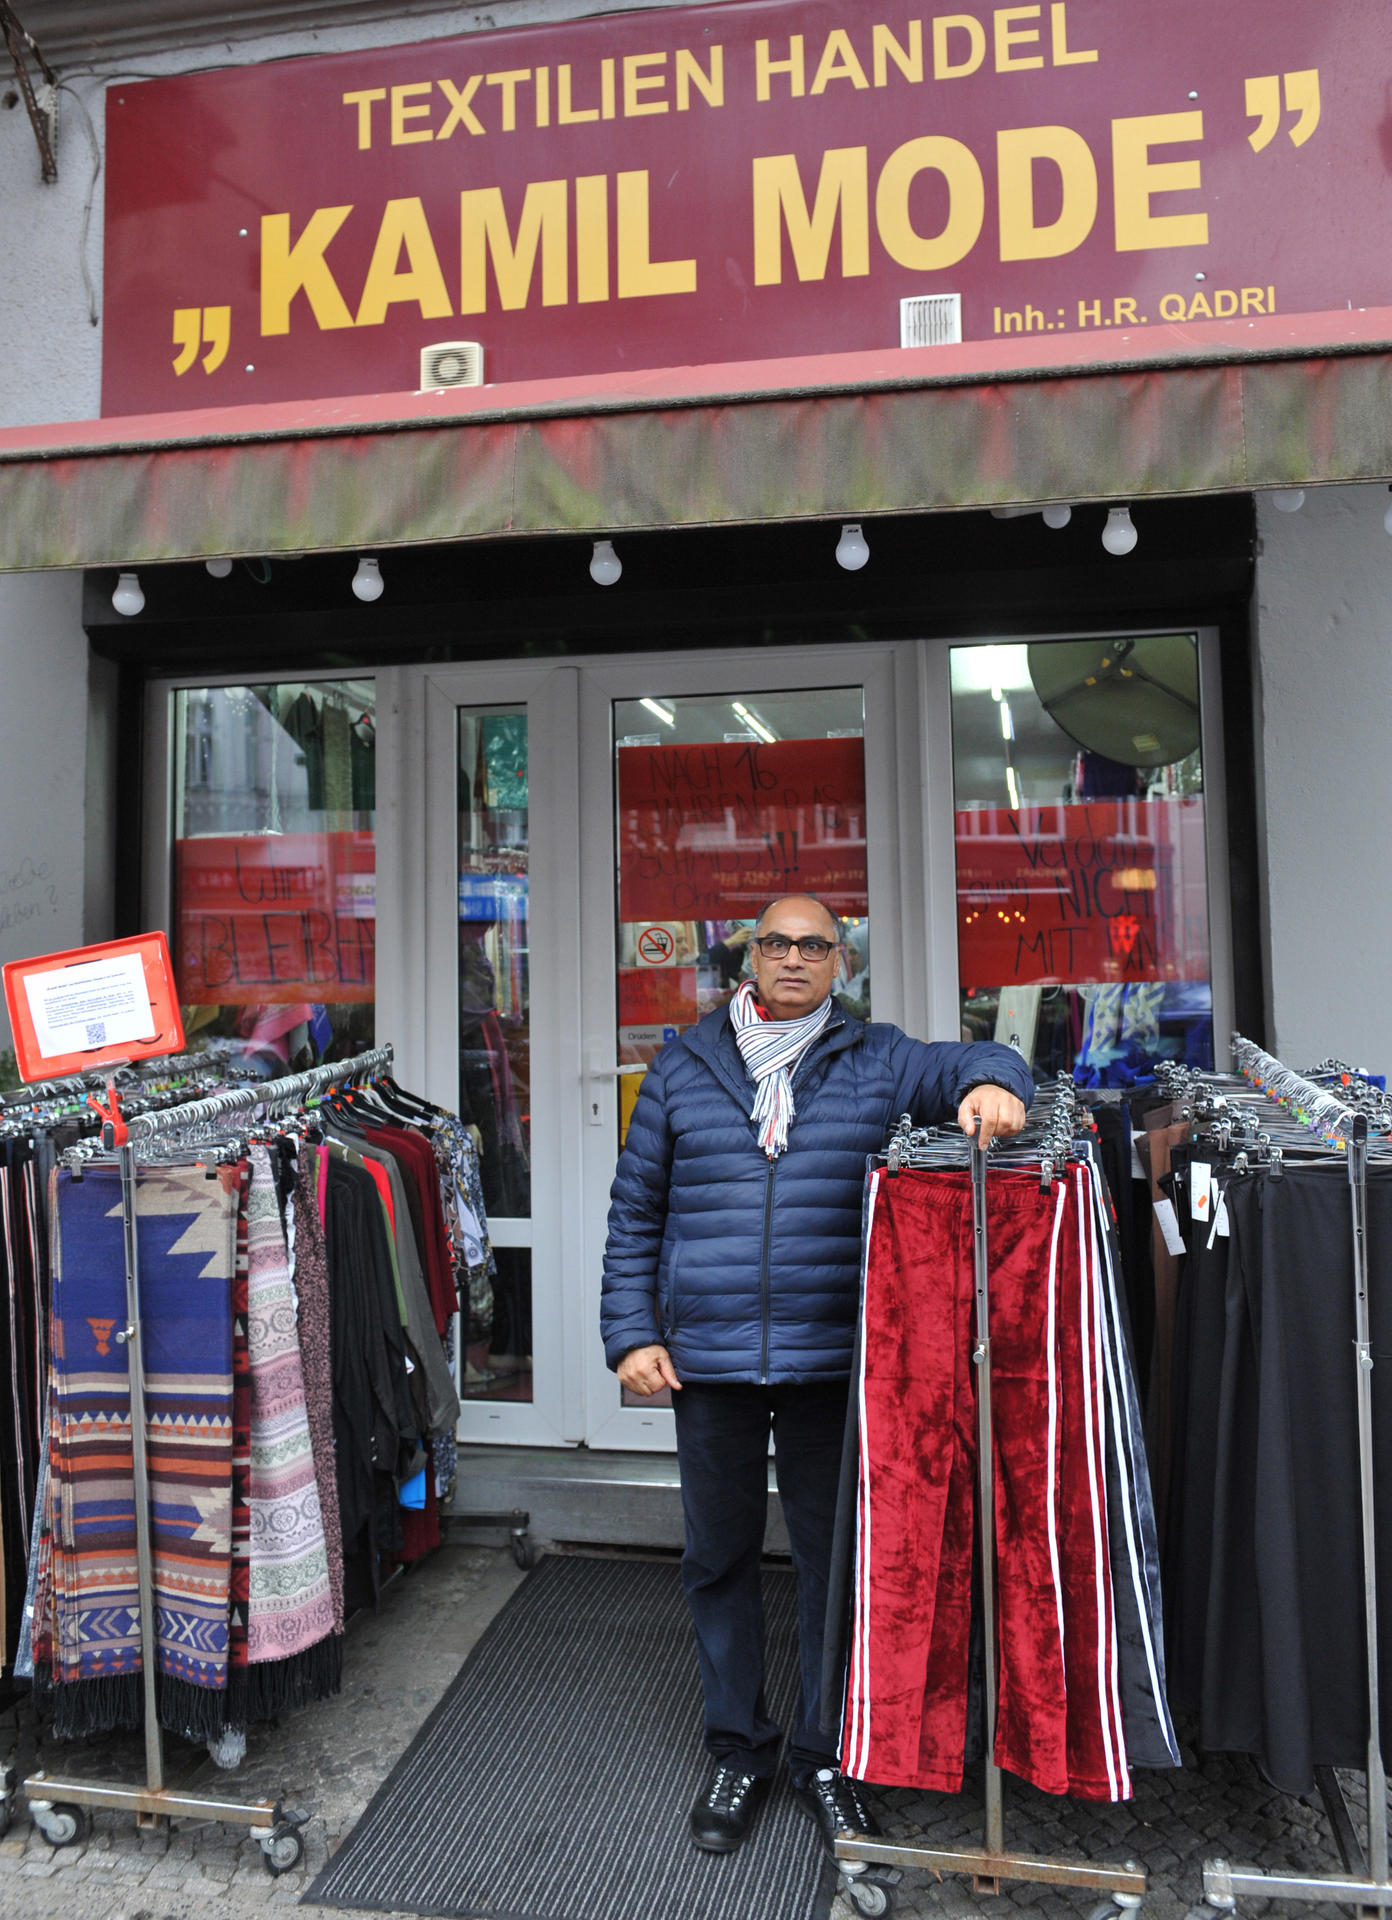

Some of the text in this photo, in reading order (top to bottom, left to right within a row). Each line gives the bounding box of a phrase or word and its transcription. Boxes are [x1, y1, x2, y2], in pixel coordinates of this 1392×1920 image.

[343, 2, 1099, 150] TEXTILIEN HANDEL
[260, 170, 697, 337] KAMIL
[753, 110, 1209, 286] MODE
[994, 285, 1276, 333] Inh.: H.R. QADRI
[648, 743, 779, 792] NACH 16
[1013, 925, 1089, 977] MIT
